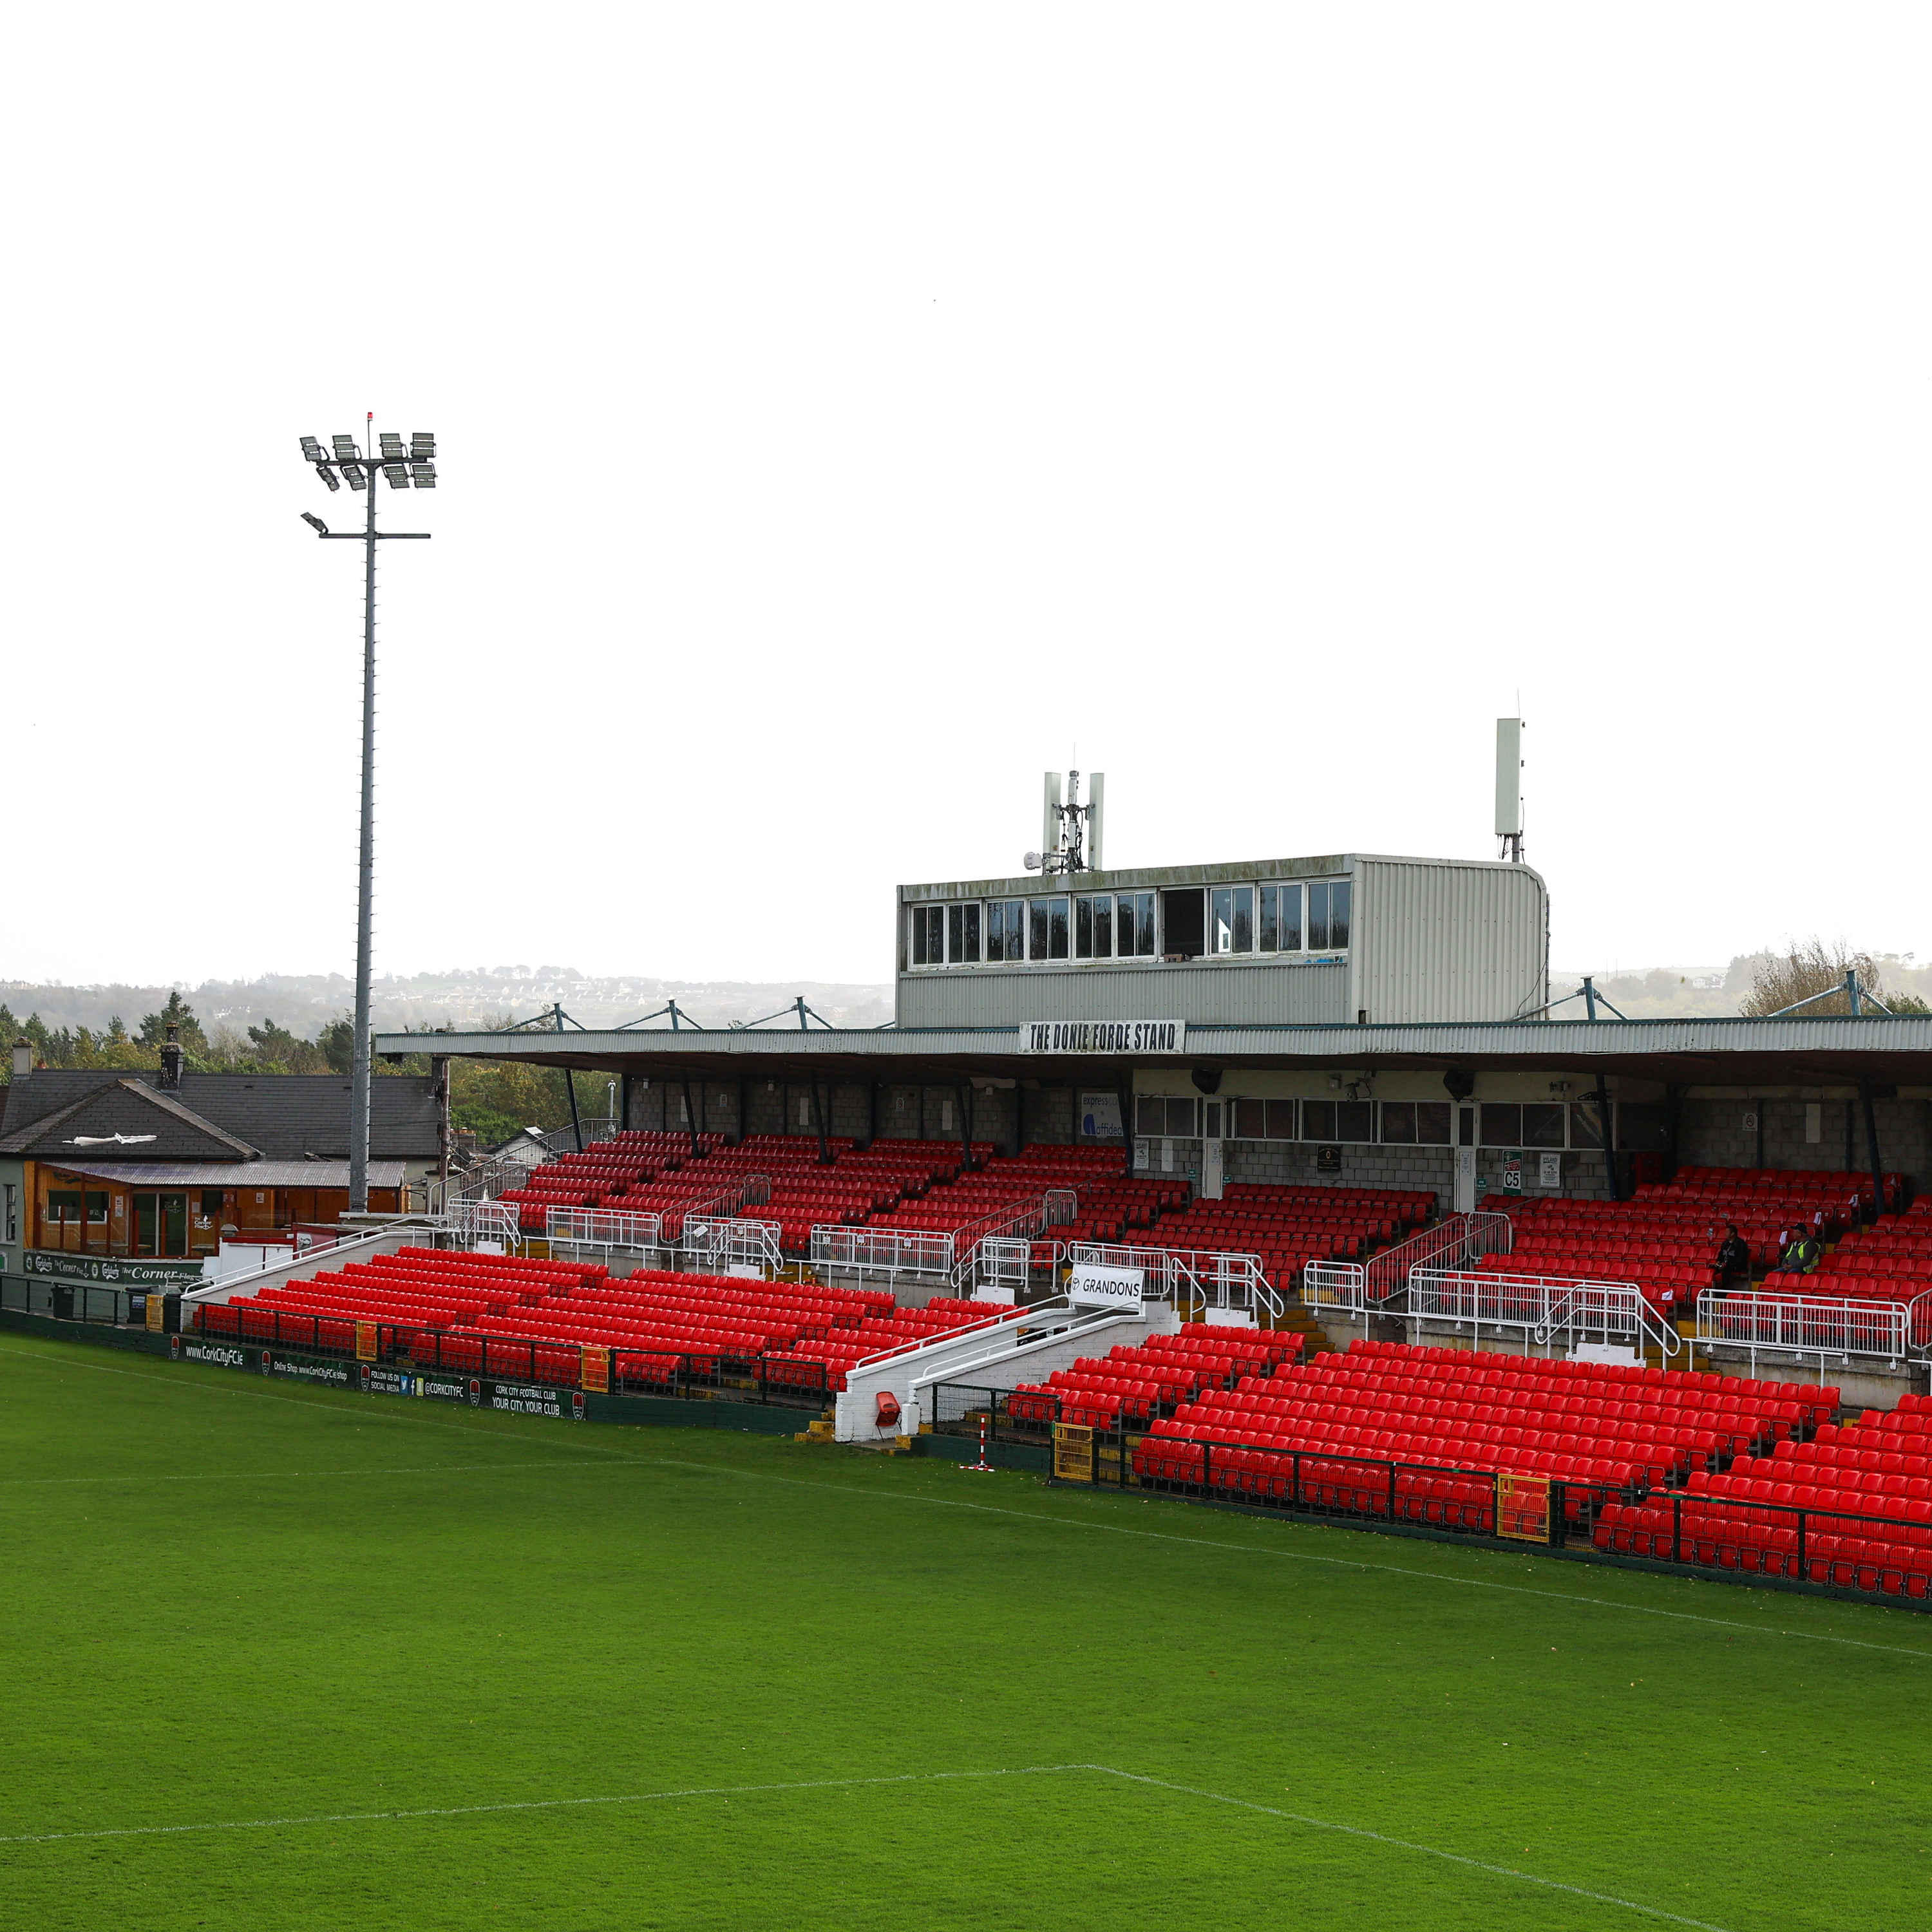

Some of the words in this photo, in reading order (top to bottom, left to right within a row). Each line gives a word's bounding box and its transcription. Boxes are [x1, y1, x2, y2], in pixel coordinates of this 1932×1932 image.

[1030, 1024, 1050, 1050] THE
[1054, 1024, 1090, 1050] DONIE
[1093, 1023, 1131, 1050] FORDE
[1134, 1023, 1176, 1050] STAND
[1096, 1123, 1122, 1135] affidea
[1505, 1172, 1519, 1187] C5
[35, 1256, 52, 1273] Carlsberg
[59, 1260, 77, 1273] Corner
[102, 1263, 119, 1280] Carlsberg
[131, 1267, 178, 1279] Corner
[1083, 1278, 1140, 1297] GRANDONS
[185, 1346, 243, 1366] www.CorkCityFC.ie
[274, 1361, 287, 1371] Online
[371, 1370, 386, 1379] FOLLOW
[387, 1373, 393, 1381] US
[371, 1381, 386, 1390] SOCIAL
[386, 1383, 400, 1393] MEDIA
[425, 1382, 464, 1397] @CORKCITYFC
[495, 1385, 508, 1395] CORK
[508, 1387, 519, 1396] CITY
[519, 1388, 543, 1399] FOOTBALL
[543, 1390, 556, 1401] CLUB
[492, 1396, 509, 1409] YOUR
[525, 1400, 542, 1414] YOUR
[544, 1403, 560, 1416] CLUB
